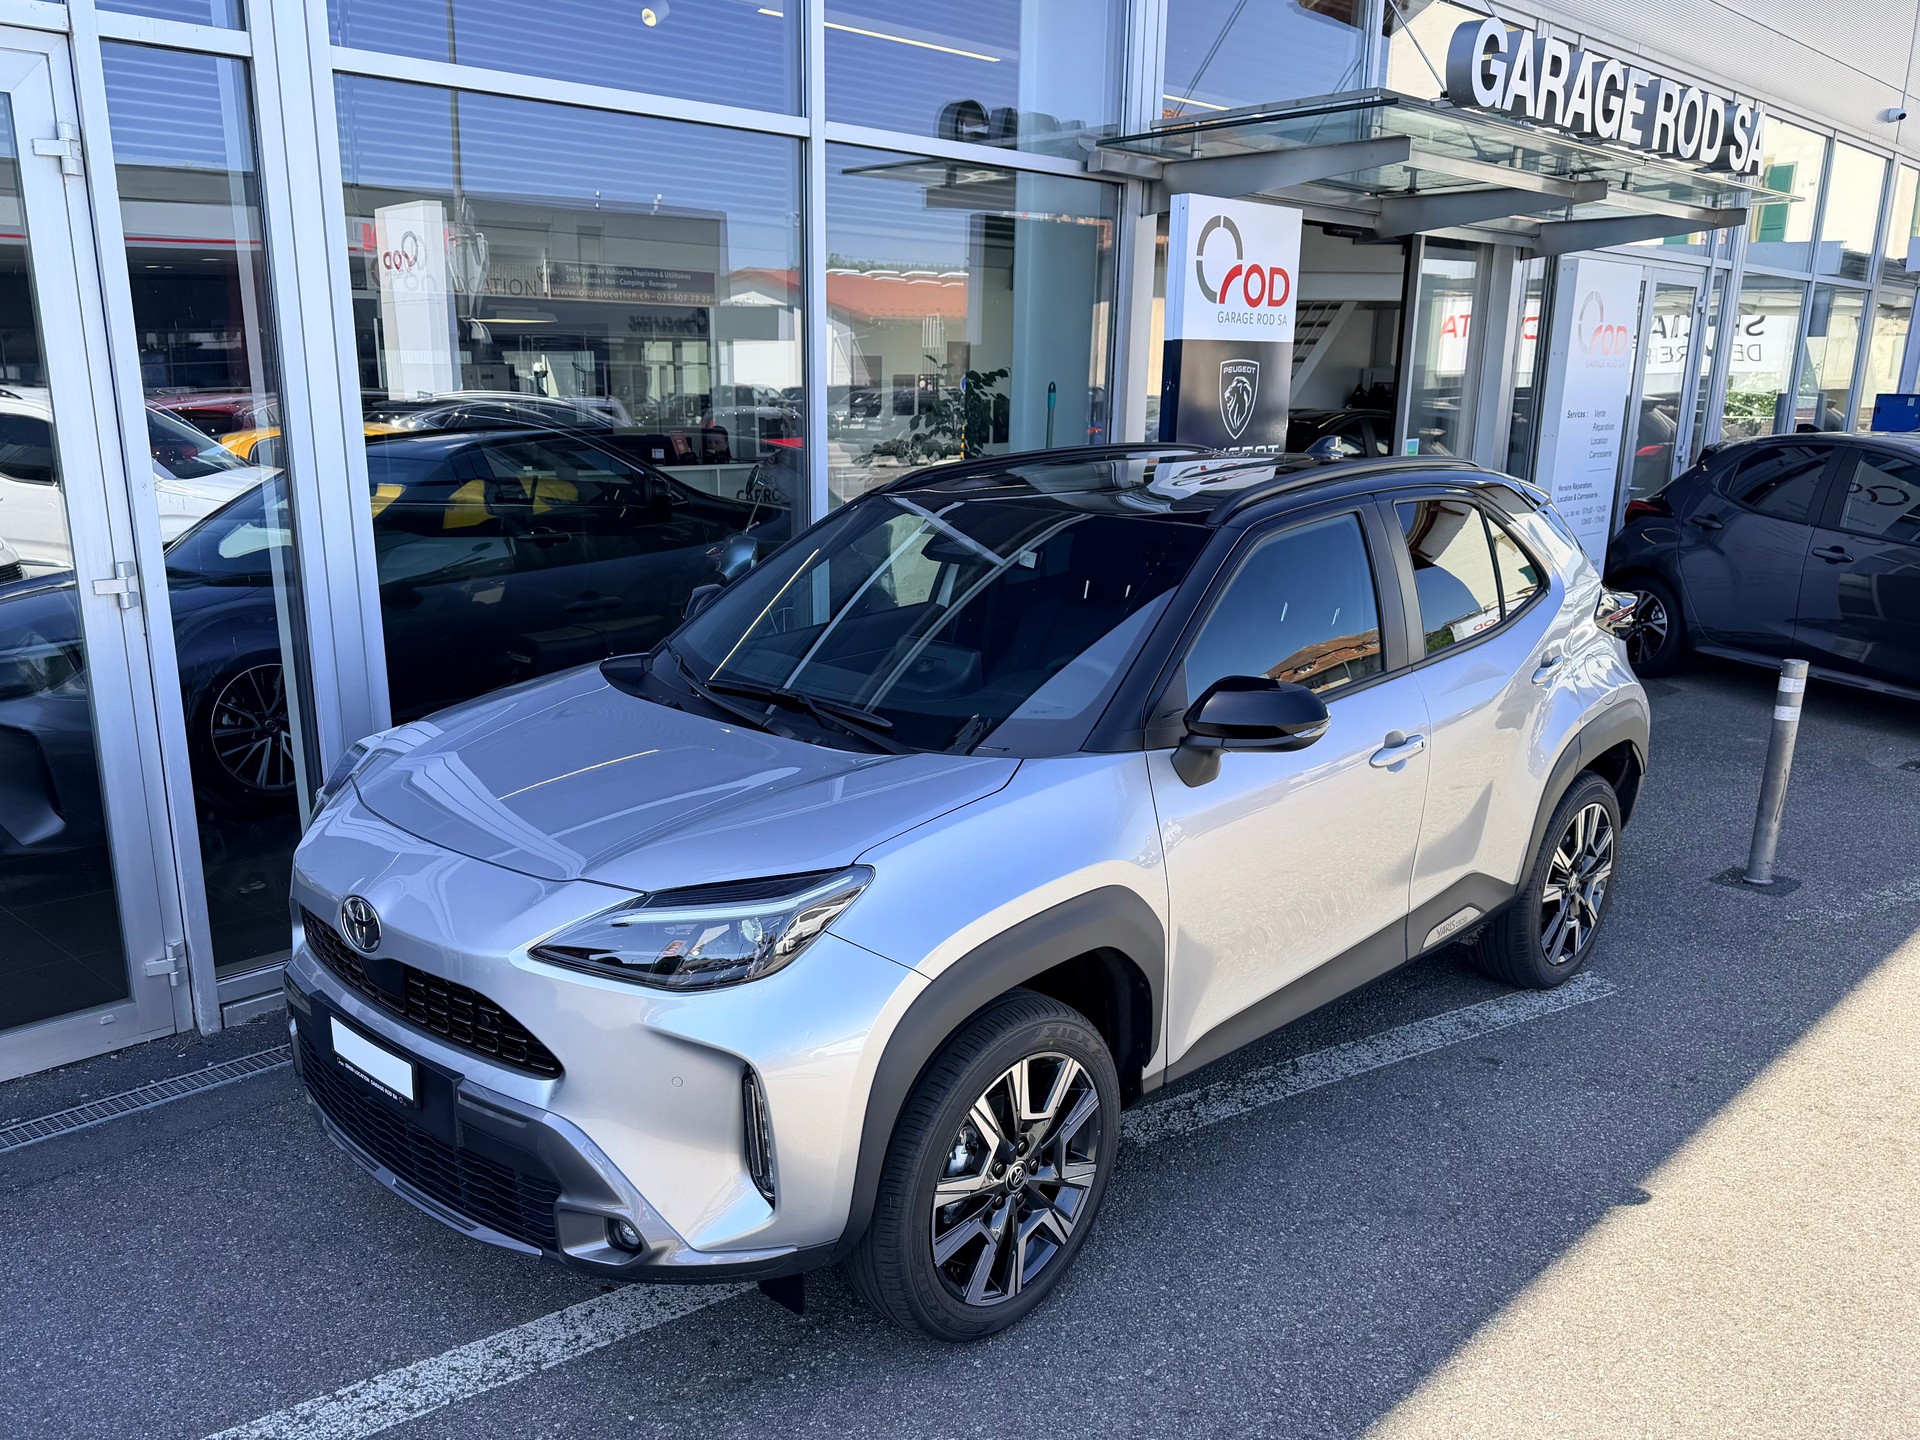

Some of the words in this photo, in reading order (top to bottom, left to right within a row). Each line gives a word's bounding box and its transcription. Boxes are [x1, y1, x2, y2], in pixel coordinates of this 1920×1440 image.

[1471, 17, 1651, 145] GARAGE
[1652, 77, 1725, 164] ROD
[1728, 102, 1765, 176] SA
[580, 266, 596, 275] types
[604, 266, 633, 276] Véhicules
[634, 269, 659, 278] Tourisme
[664, 271, 691, 280] Utilitaires
[582, 276, 600, 285] places
[620, 278, 645, 288] Camping
[648, 280, 678, 289] Remorque
[552, 287, 650, 300] www.oronlocation.ch
[1217, 311, 1254, 324] GARAGE
[1257, 313, 1275, 326] ROD
[1277, 314, 1288, 326] SA
[1223, 366, 1256, 374] PEUGEOT
[1567, 410, 1586, 418] Services
[1594, 408, 1606, 418] Vente
[1592, 422, 1614, 432] Réparation
[1590, 437, 1608, 446] Location
[1589, 450, 1612, 459] Carrosserie
[1436, 920, 1456, 938] YARIS
[1045, 1024, 1091, 1048] ZIEX
